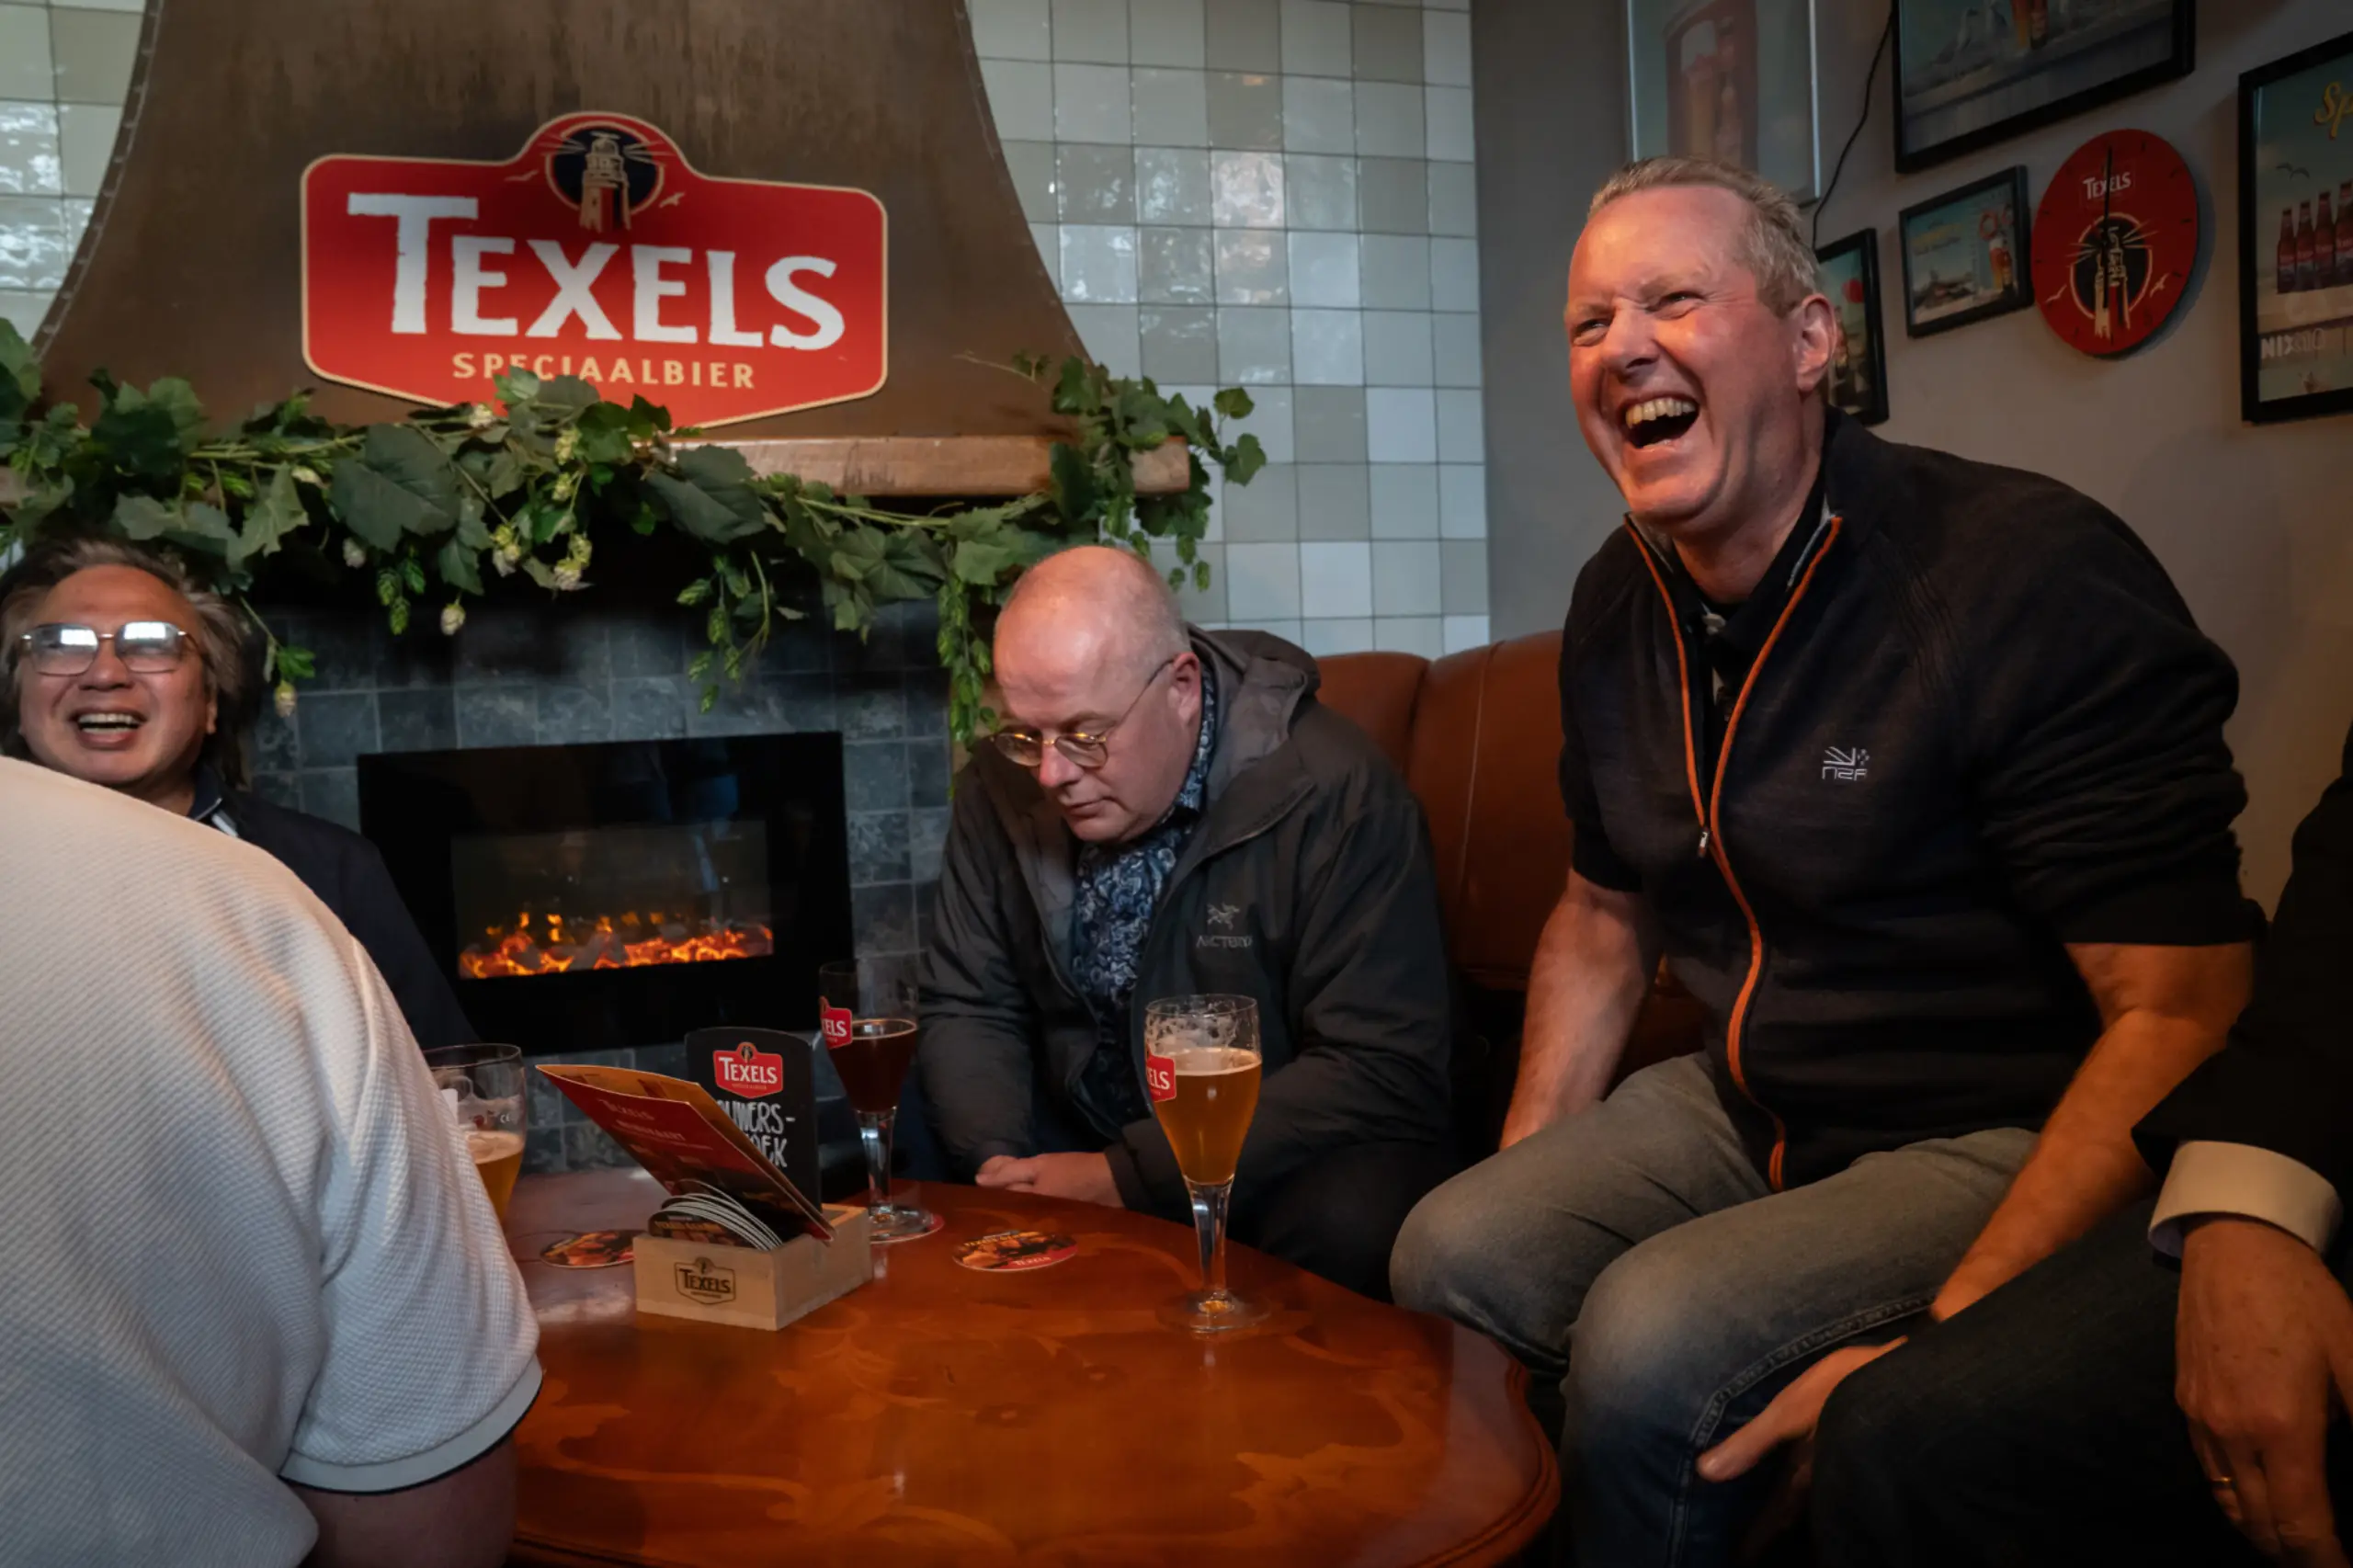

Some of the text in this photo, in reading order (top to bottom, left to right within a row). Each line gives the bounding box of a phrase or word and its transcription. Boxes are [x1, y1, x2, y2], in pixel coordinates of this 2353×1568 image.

[347, 192, 845, 350] TEXELS
[719, 1056, 778, 1085] TEXELS
[679, 1267, 732, 1294] TEXELS
